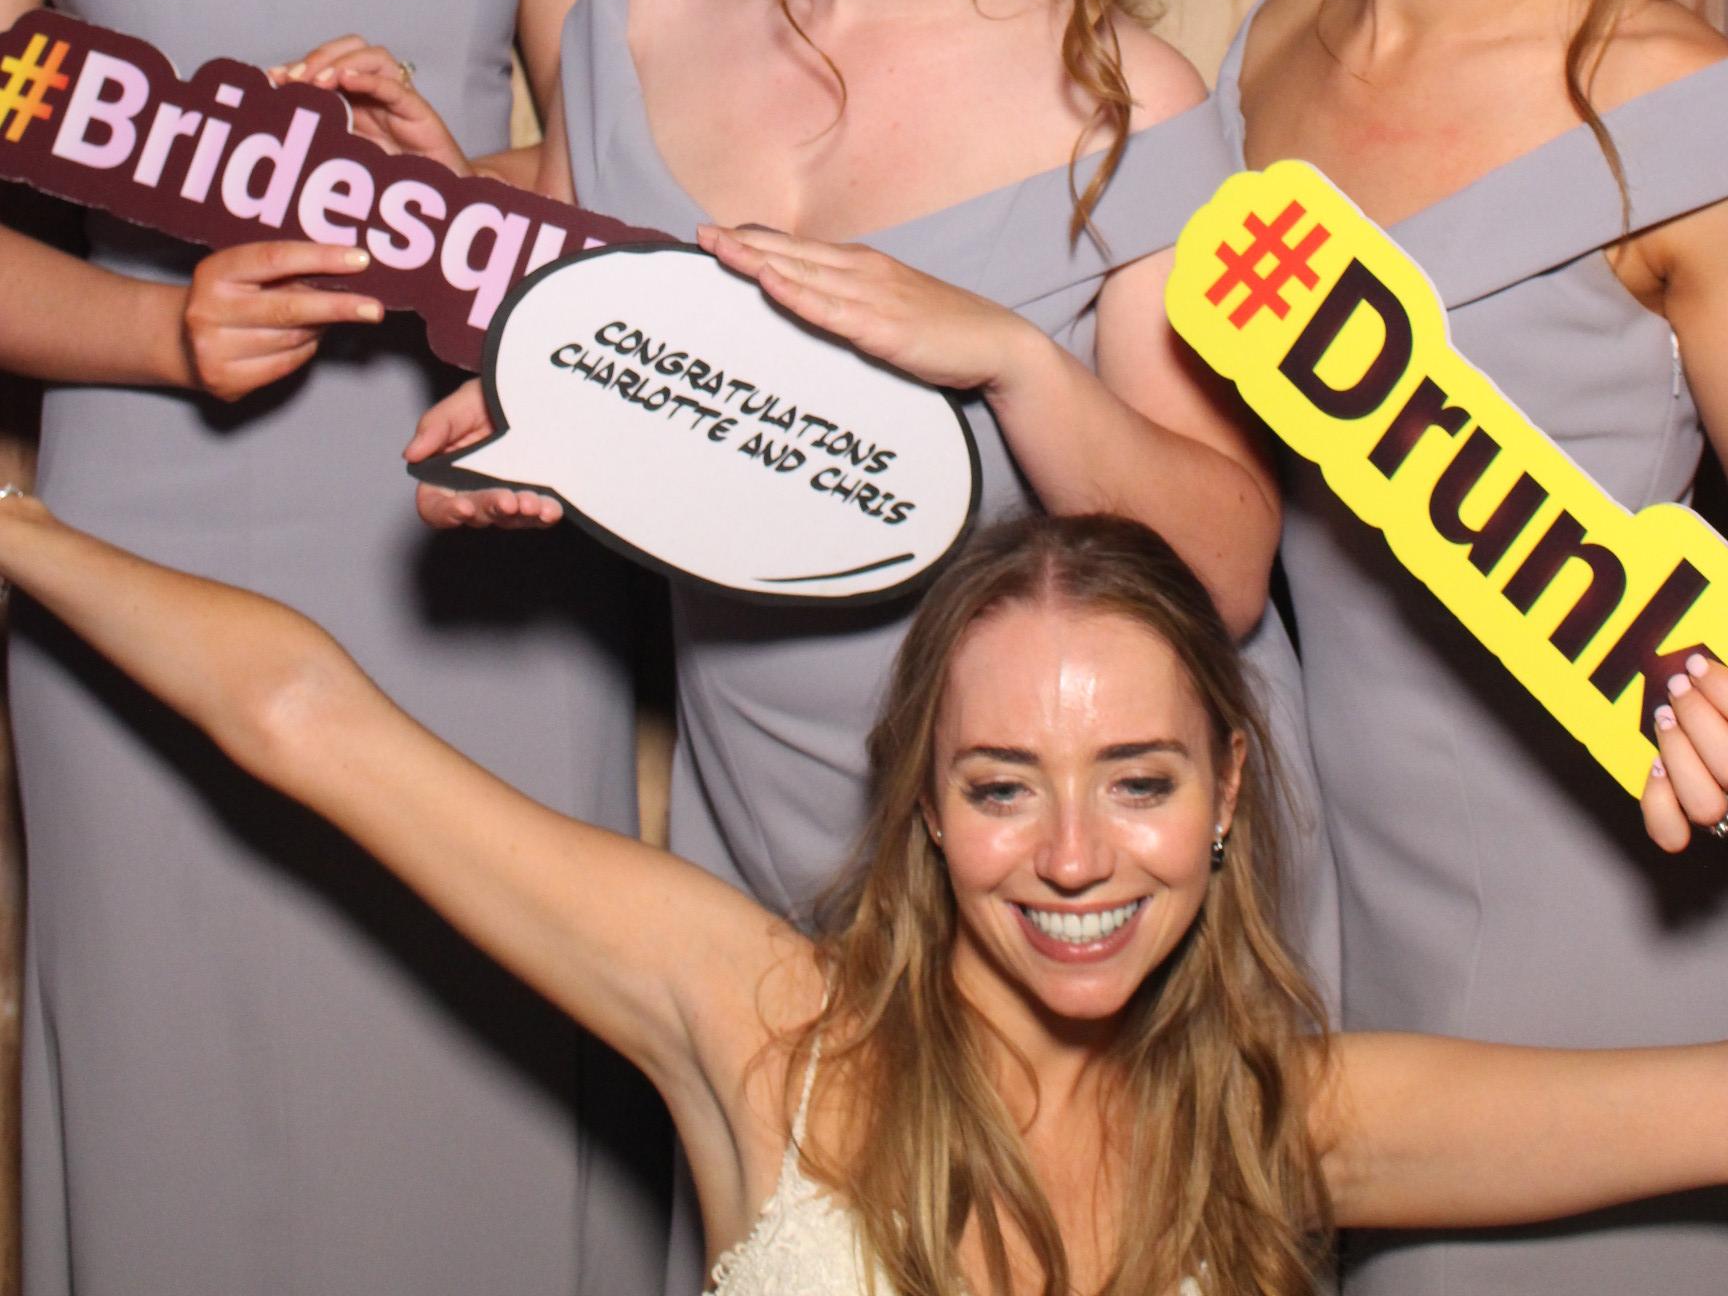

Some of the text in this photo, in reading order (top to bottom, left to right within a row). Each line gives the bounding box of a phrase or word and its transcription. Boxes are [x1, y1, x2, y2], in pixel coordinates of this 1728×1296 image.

[550, 343, 916, 524] CHARLOTTE AND CHRIS
[594, 321, 897, 473] CONGRATULATIONS
[1204, 199, 1728, 753] #Drunk
